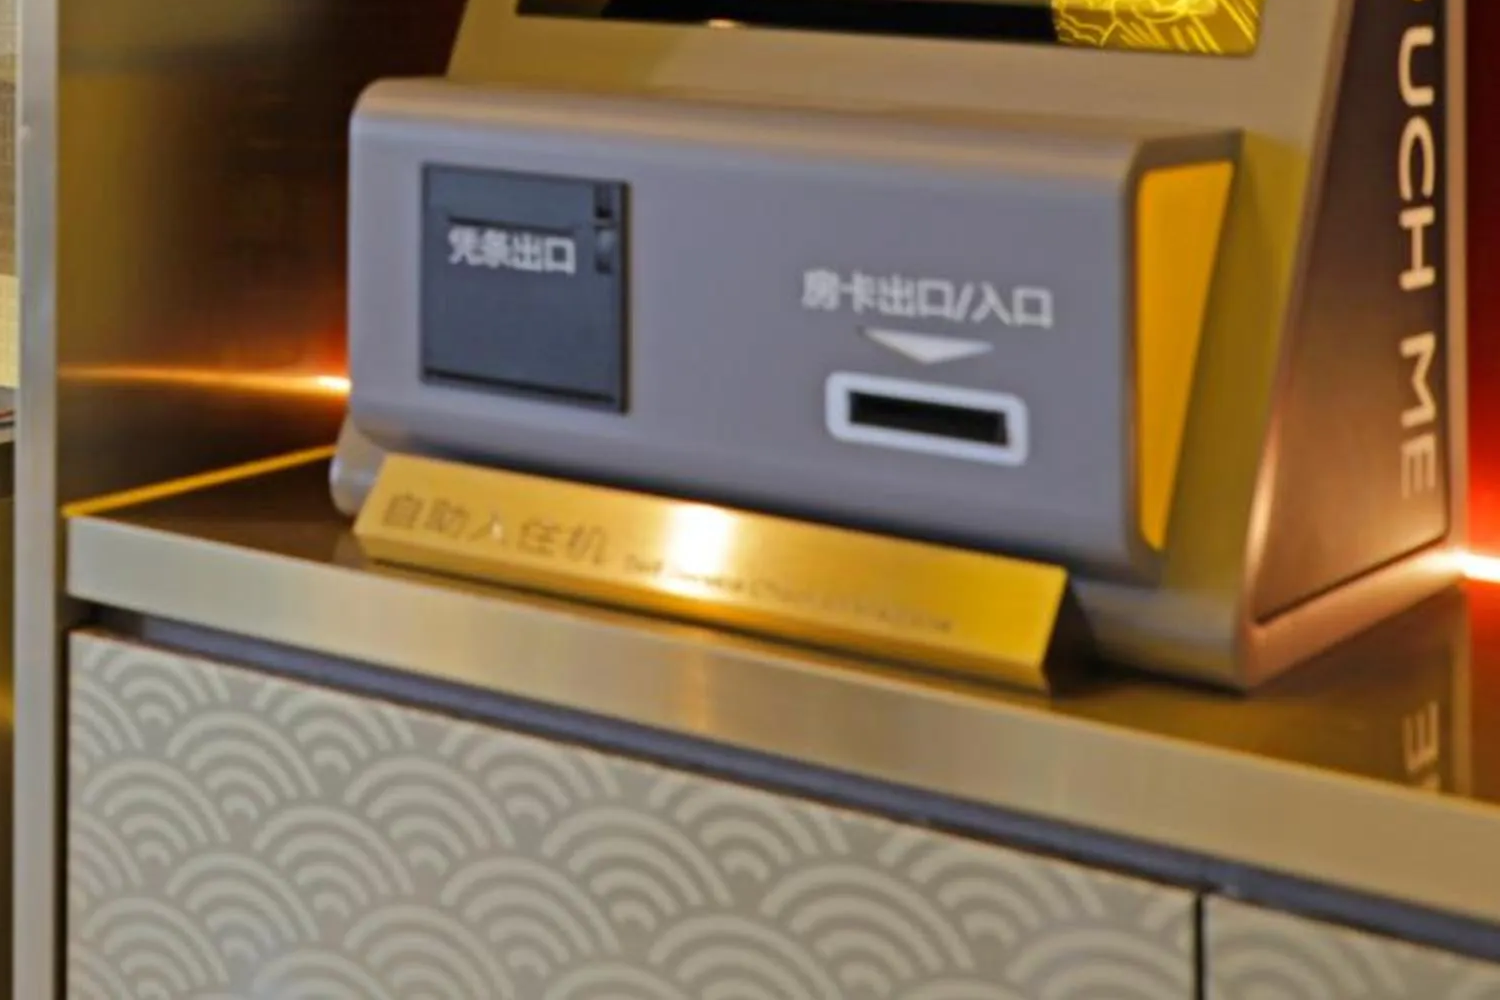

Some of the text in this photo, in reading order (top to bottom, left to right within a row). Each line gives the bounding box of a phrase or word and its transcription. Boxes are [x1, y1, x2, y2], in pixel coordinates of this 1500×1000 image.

[447, 225, 577, 275] 凭条出口
[801, 267, 1054, 329] 房卡出口/入口
[1400, 331, 1437, 498] ME
[382, 492, 608, 566] 自助入住机
